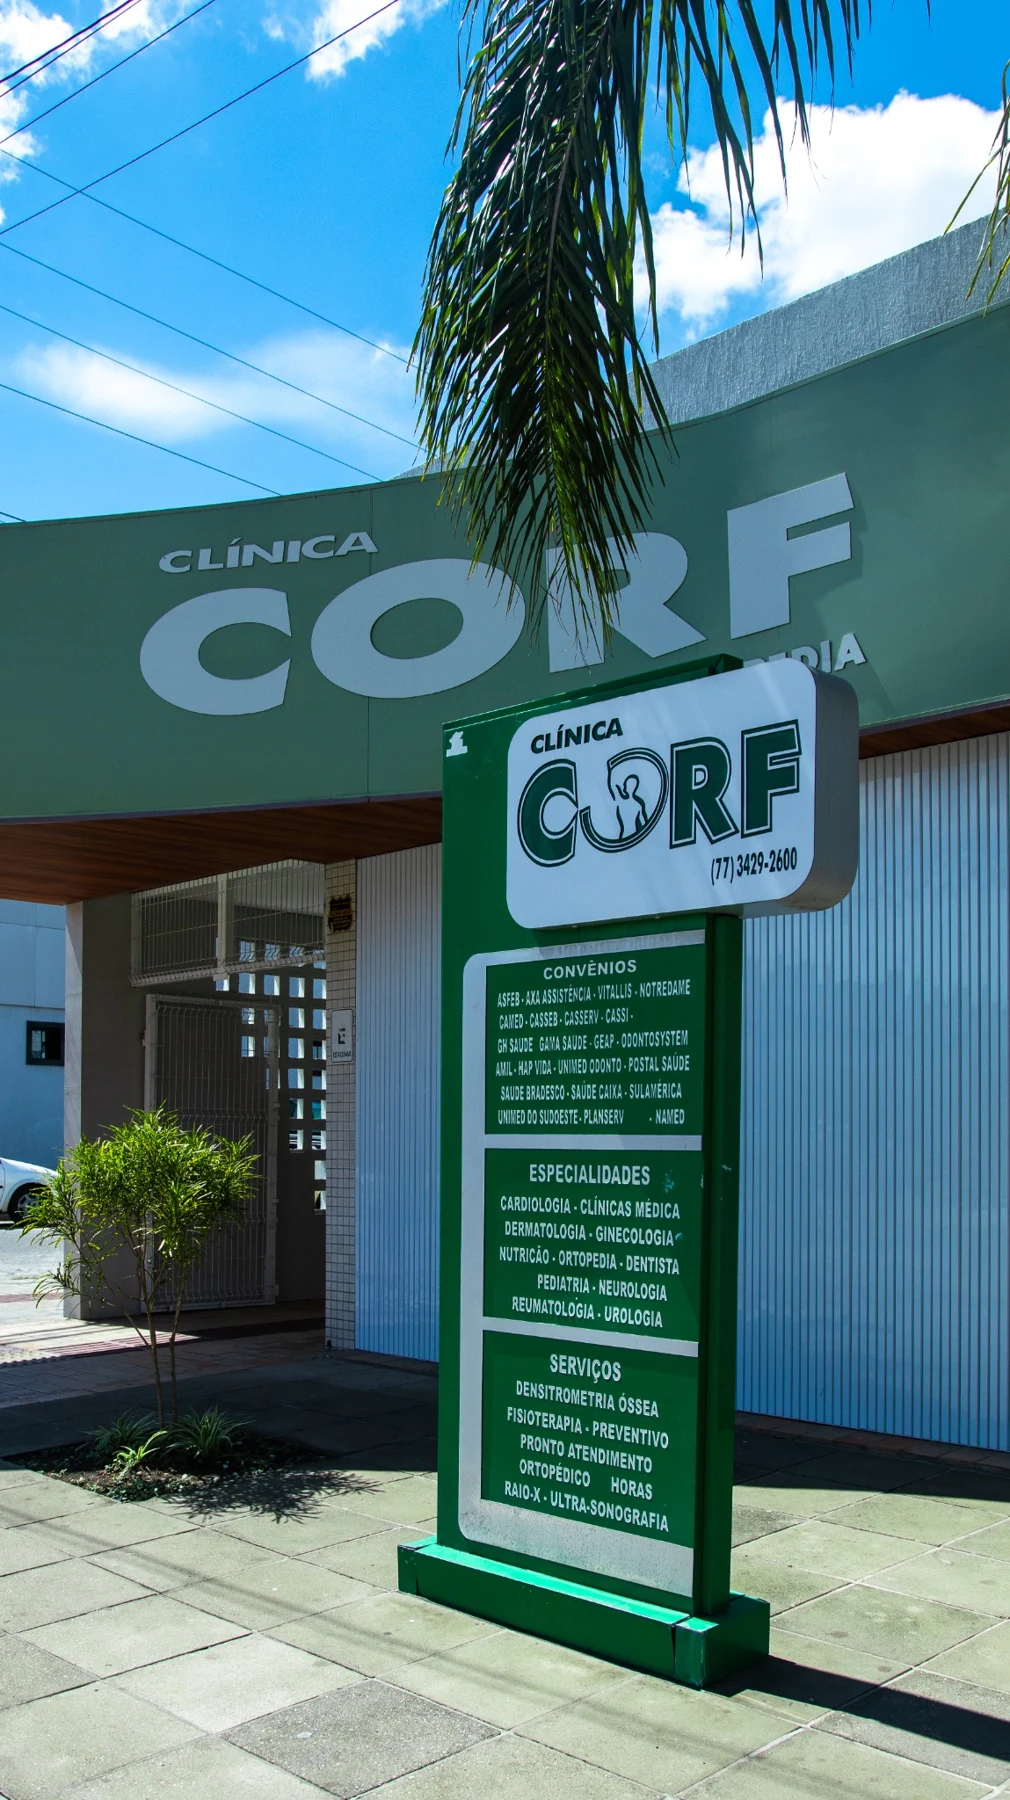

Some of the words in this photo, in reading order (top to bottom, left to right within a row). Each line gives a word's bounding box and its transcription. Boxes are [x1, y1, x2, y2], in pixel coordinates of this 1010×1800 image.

[158, 531, 379, 573] CLÍNICA
[140, 472, 855, 715] CORF
[530, 717, 624, 754] CLÍNICA
[710, 855, 735, 886] (77)
[736, 846, 798, 878] 3429-2600
[543, 959, 637, 980] CONVÊNIOS
[497, 991, 520, 1008] ASFEB
[525, 989, 541, 1005] AXA
[597, 983, 632, 1000] VITALLIS
[639, 978, 691, 997] NOTREDAME
[499, 1013, 524, 1030] CAMED
[529, 1011, 558, 1028] CASSEB
[564, 1010, 599, 1026] CASSERV
[605, 1007, 629, 1024] CASSI
[497, 1037, 507, 1054] GH
[562, 1034, 587, 1051] SAUDE
[594, 1034, 615, 1049] GEAP
[621, 1029, 689, 1049] ODONTOSYSTEM
[495, 1061, 513, 1077] AMIL
[518, 1060, 533, 1076] HAP
[534, 1060, 552, 1075] VIDA
[558, 1058, 587, 1075] UNIMED
[589, 1057, 622, 1074] ODONTO
[628, 1056, 660, 1073] POSTAL
[661, 1052, 690, 1072] SAÚDE
[500, 1085, 525, 1101] SAUDE
[526, 1085, 565, 1100] BRADESCO
[598, 1084, 622, 1100] CAIXA
[629, 1079, 682, 1099] SULAMÉRICA
[497, 1109, 526, 1125] UNIMED
[527, 1109, 537, 1125] DO
[539, 1109, 578, 1125] SUDOESTE
[583, 1109, 625, 1125] PLANSERV
[655, 1108, 685, 1125] NAMED
[529, 1163, 650, 1186] ESPECIALIDADES
[500, 1195, 571, 1214] CARDIOLOGIA
[580, 1195, 632, 1217] CLÍNICAS
[635, 1198, 680, 1220] MÉDICA
[504, 1220, 587, 1240] DERMATOLOGIA
[595, 1226, 674, 1247] GINECOLOGIA
[559, 1250, 617, 1270] ORTOPEDIA
[626, 1255, 680, 1275] DENTISTA
[537, 1273, 590, 1294] PEDIATRIA
[599, 1279, 667, 1302] NEUROLOGIA
[512, 1296, 595, 1320] REUMATOLOGIA
[604, 1306, 663, 1328] UROLOGIA
[550, 1353, 622, 1384] SERVIÇOS
[516, 1380, 615, 1411] DENSITROMETRIA
[618, 1392, 659, 1418] ÓSSEA
[507, 1406, 583, 1435] FISIOTERAPIA
[592, 1420, 669, 1449] PREVENTIVO
[520, 1433, 565, 1457] PRONTO
[568, 1442, 653, 1474] ATENDIMENTO
[519, 1458, 591, 1488] ORTOPÉDICO
[611, 1476, 653, 1501] HORAS
[504, 1480, 541, 1503] RAIO-X
[550, 1490, 669, 1532] ULTRA-SONOGRAFIA
